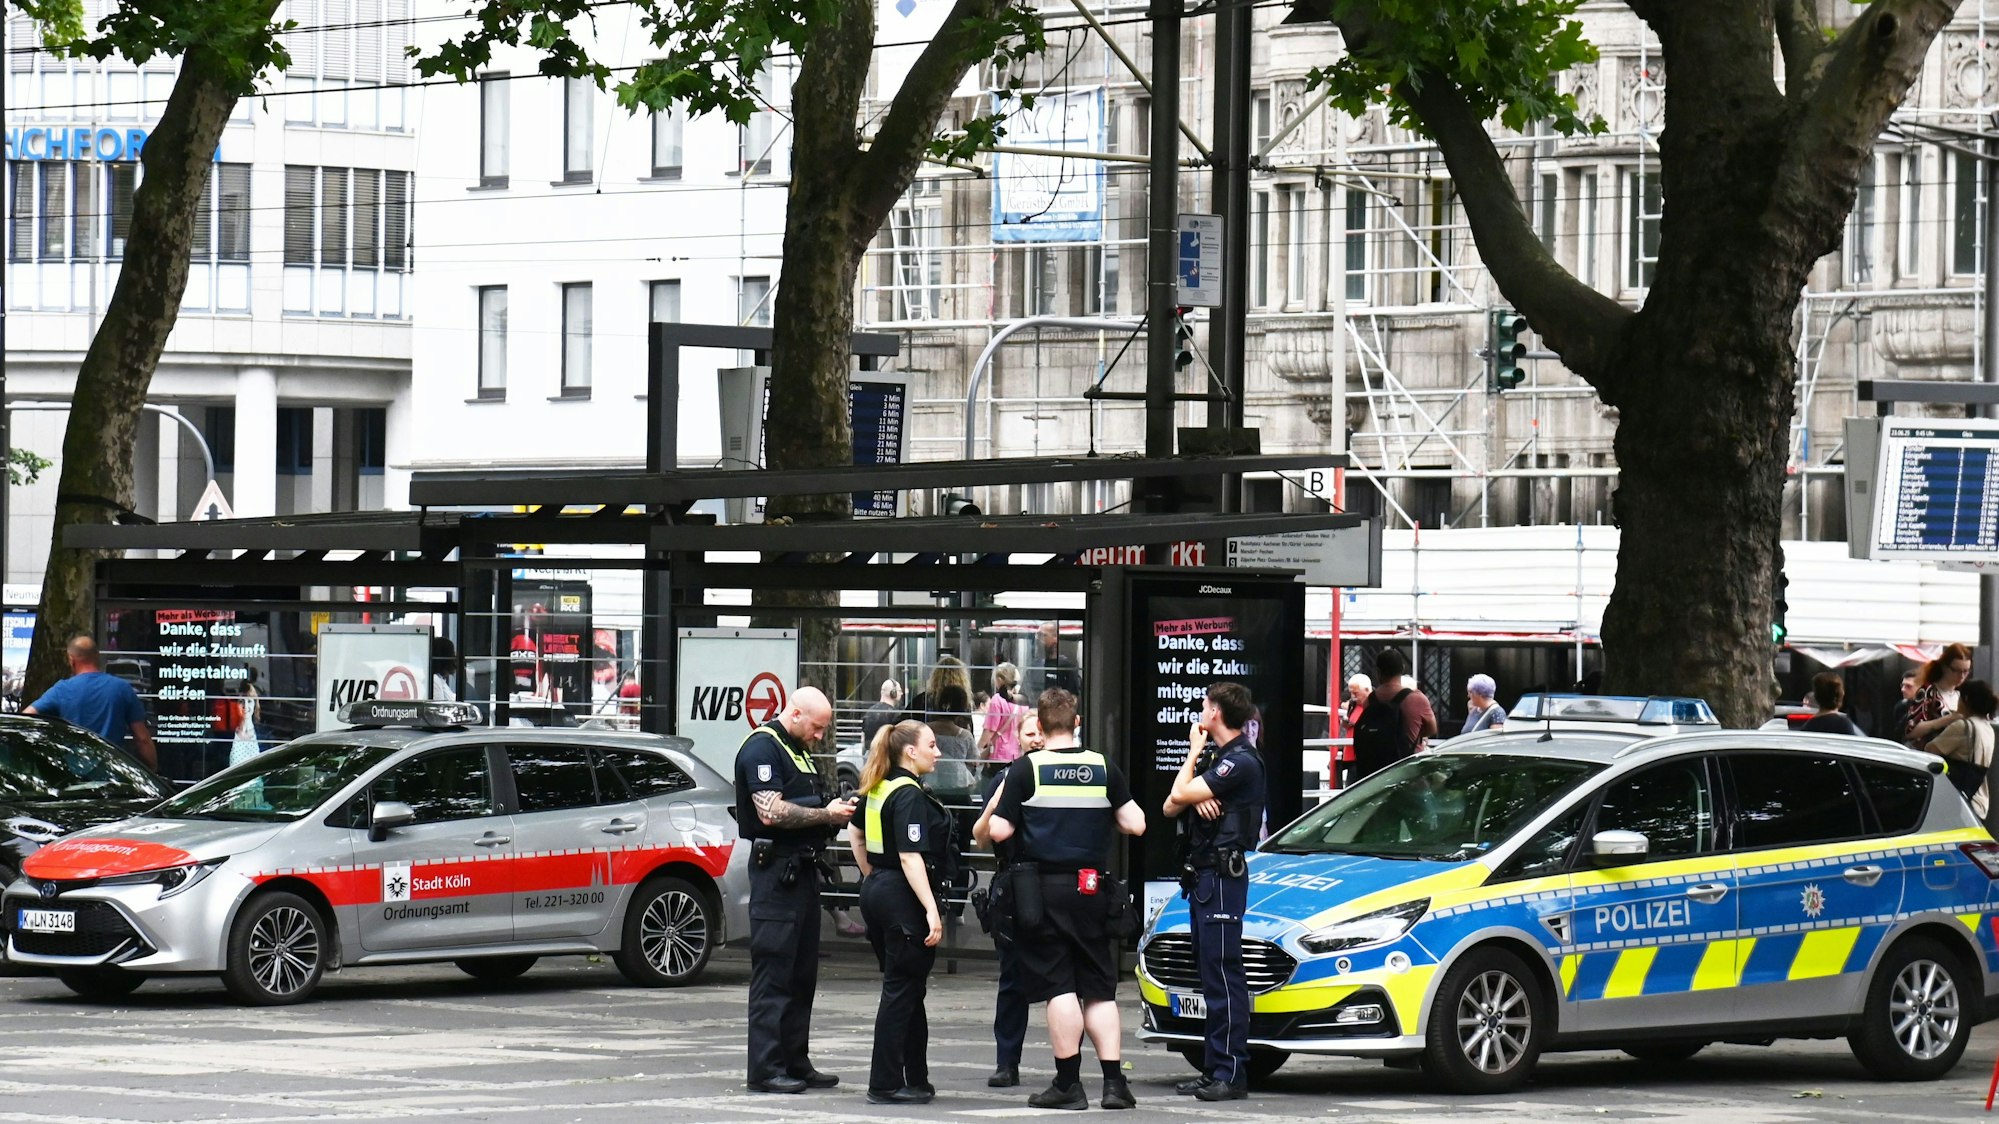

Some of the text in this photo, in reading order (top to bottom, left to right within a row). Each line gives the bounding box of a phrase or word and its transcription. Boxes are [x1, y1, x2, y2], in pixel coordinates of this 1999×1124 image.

[1310, 472, 1324, 492] B
[854, 508, 866, 516] Bitte
[1075, 541, 1205, 567] Neumrkt
[5, 589, 40, 600] Neuma
[1199, 585, 1232, 594] JCDecaux
[158, 612, 178, 620] Mehr
[160, 622, 241, 637] Danke, dass
[1156, 622, 1178, 633] Mehr
[1180, 622, 1192, 631] als
[160, 642, 266, 658] wir die Zukunft
[1158, 634, 1245, 652] Danke, dass
[159, 664, 248, 682] mitgestalten
[1158, 658, 1182, 675] wir
[1186, 658, 1209, 675] die
[159, 686, 205, 700] dürfen
[329, 679, 379, 712] KVB
[1158, 682, 1208, 703] mitges
[690, 686, 744, 721] KVB
[371, 705, 418, 720] Ordnungsamt
[1156, 756, 1180, 764] Hamburg
[1054, 769, 1077, 780] KVB
[412, 876, 471, 891] Stadt Köln
[1248, 872, 1344, 892] OLIZEI
[524, 898, 542, 909] Tel.
[590, 892, 604, 904] 00
[383, 901, 470, 921] Ordnungsamt
[1595, 899, 1690, 934] POLIZEI
[23, 912, 73, 928] K LN 3148
